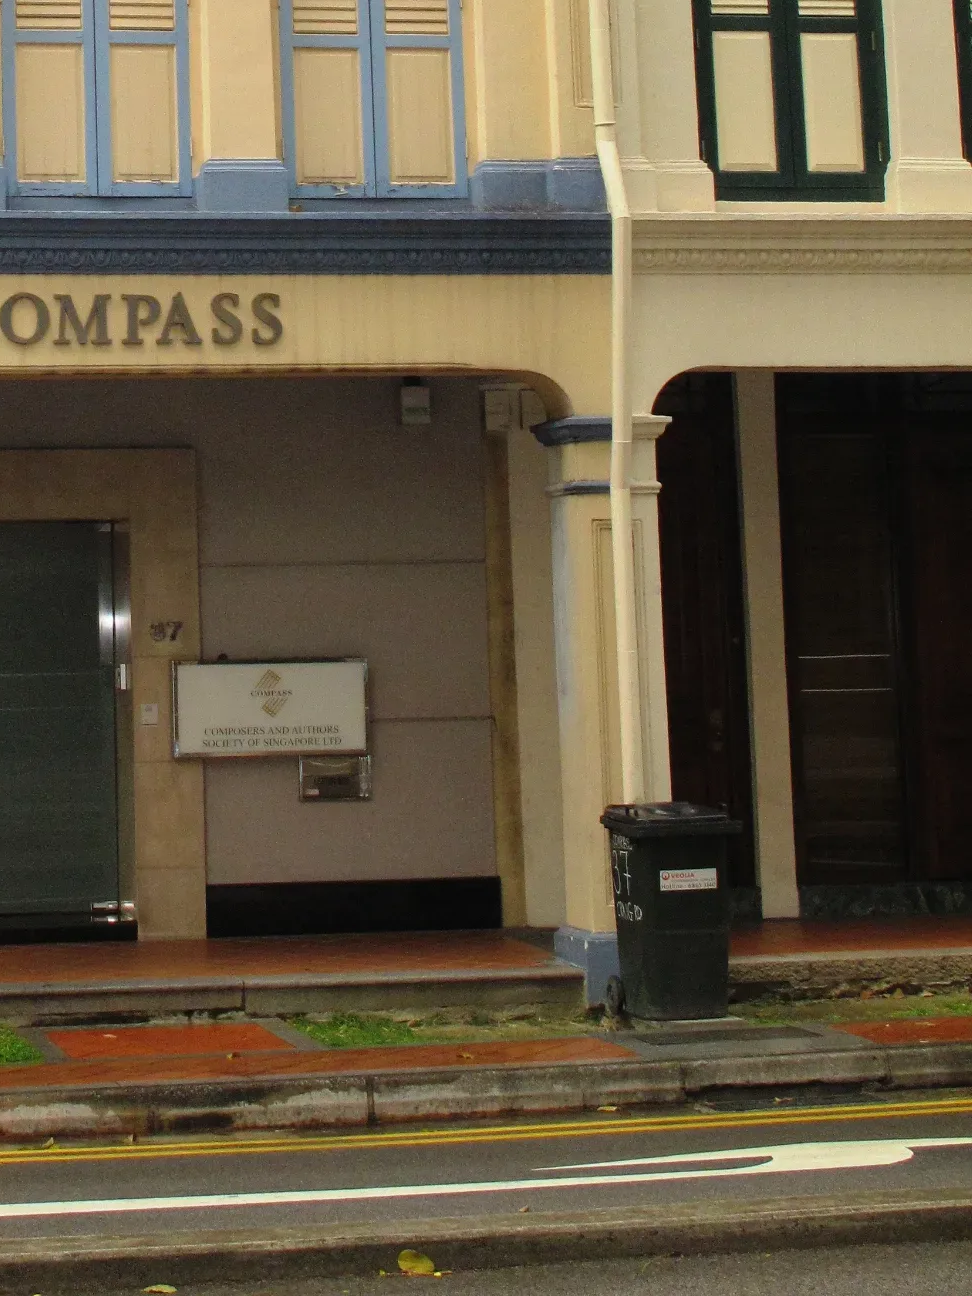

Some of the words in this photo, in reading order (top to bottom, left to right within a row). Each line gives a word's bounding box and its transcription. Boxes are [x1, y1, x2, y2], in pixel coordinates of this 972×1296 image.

[250, 689, 293, 697] COMPASS
[204, 726, 265, 736] COMPOSERS
[268, 726, 289, 735] AND
[291, 725, 339, 735] AUTHORS
[202, 738, 244, 748] SOCIETY
[247, 738, 261, 747] OF
[263, 736, 320, 747] SINGAPORE
[323, 736, 342, 746] LTD
